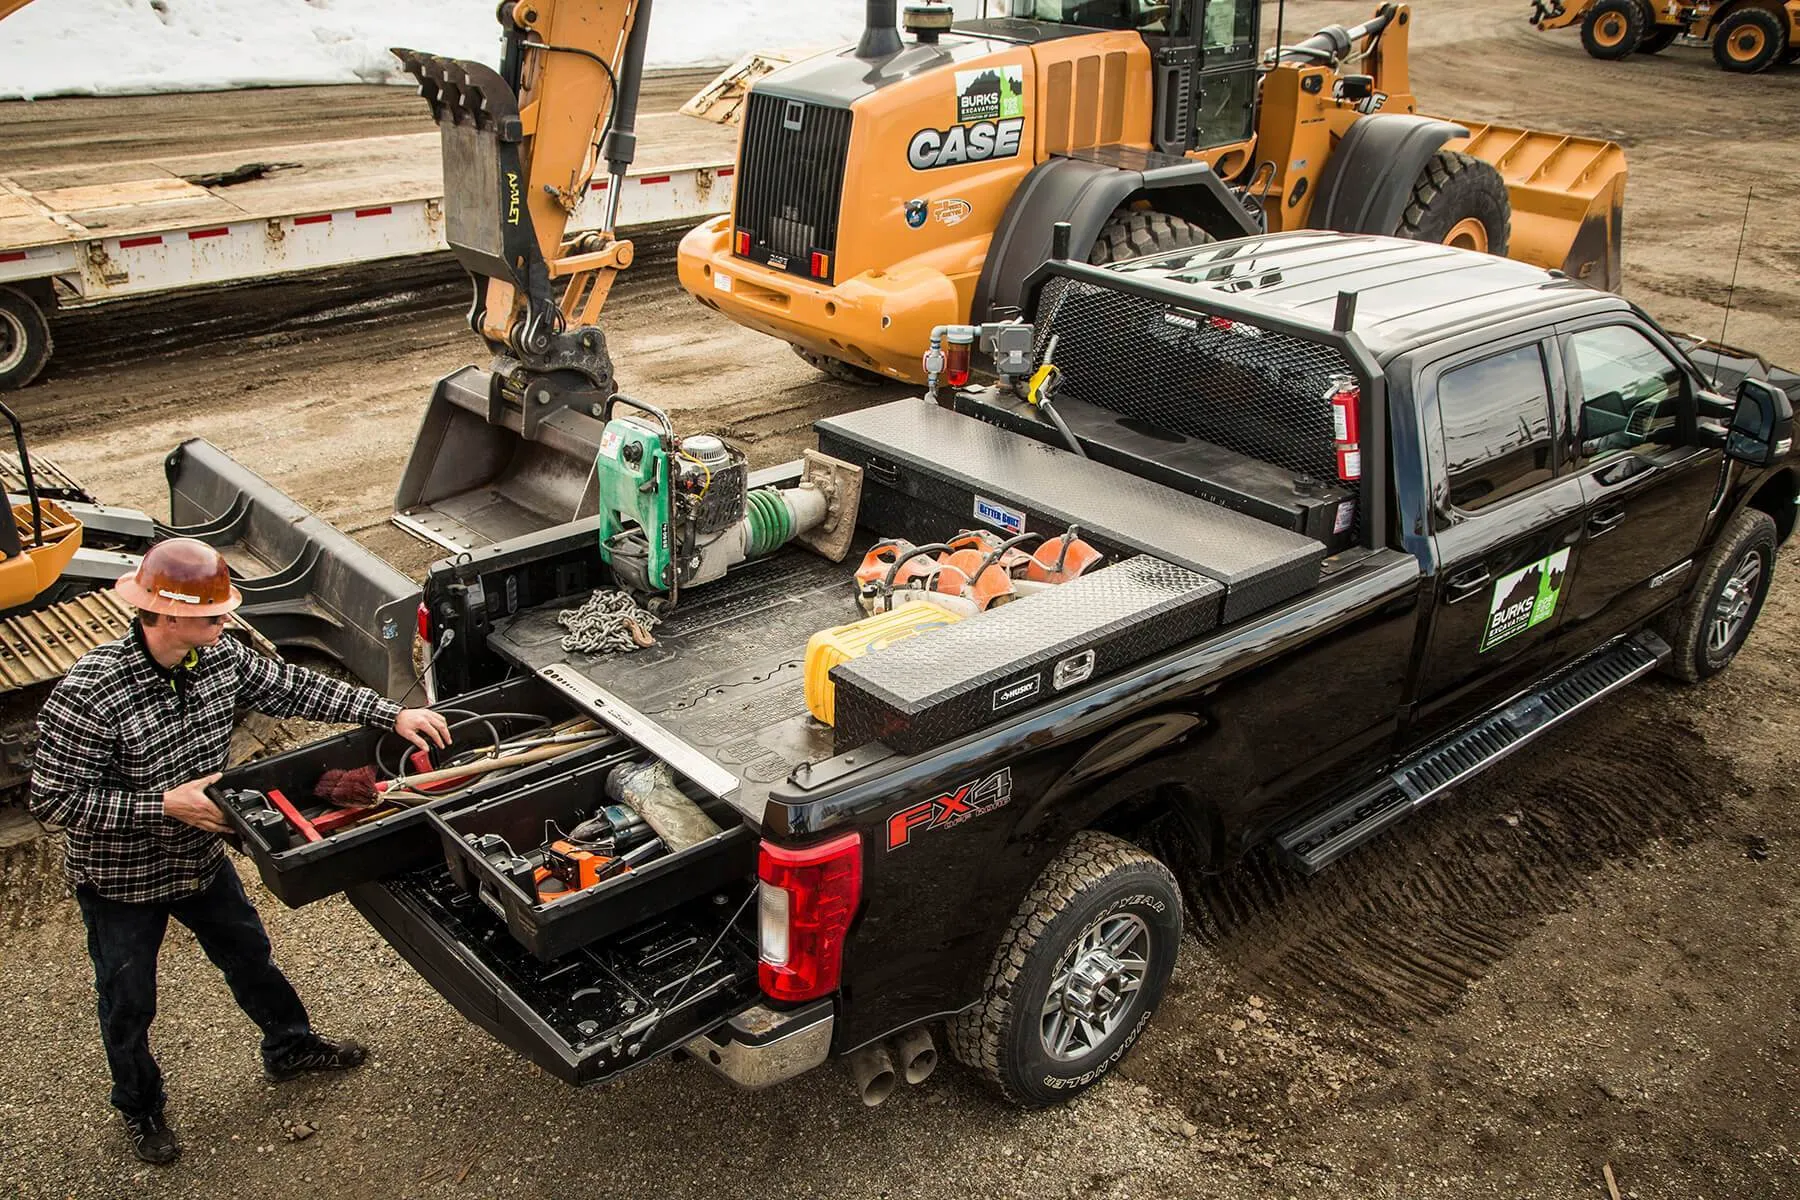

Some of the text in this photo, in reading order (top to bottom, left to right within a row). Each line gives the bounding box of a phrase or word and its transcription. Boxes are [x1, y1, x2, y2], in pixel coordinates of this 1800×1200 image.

[961, 92, 999, 108] BURKS
[961, 104, 999, 115] EXCAVATION
[907, 117, 1024, 170] CASE
[507, 172, 520, 226] AMULET
[1488, 611, 1530, 638] EXCAVATION
[1491, 596, 1535, 628] BURKS
[1009, 682, 1034, 698] HUSKY
[887, 766, 1012, 852] FX4
[1042, 1010, 1152, 1091] WRANGLER
